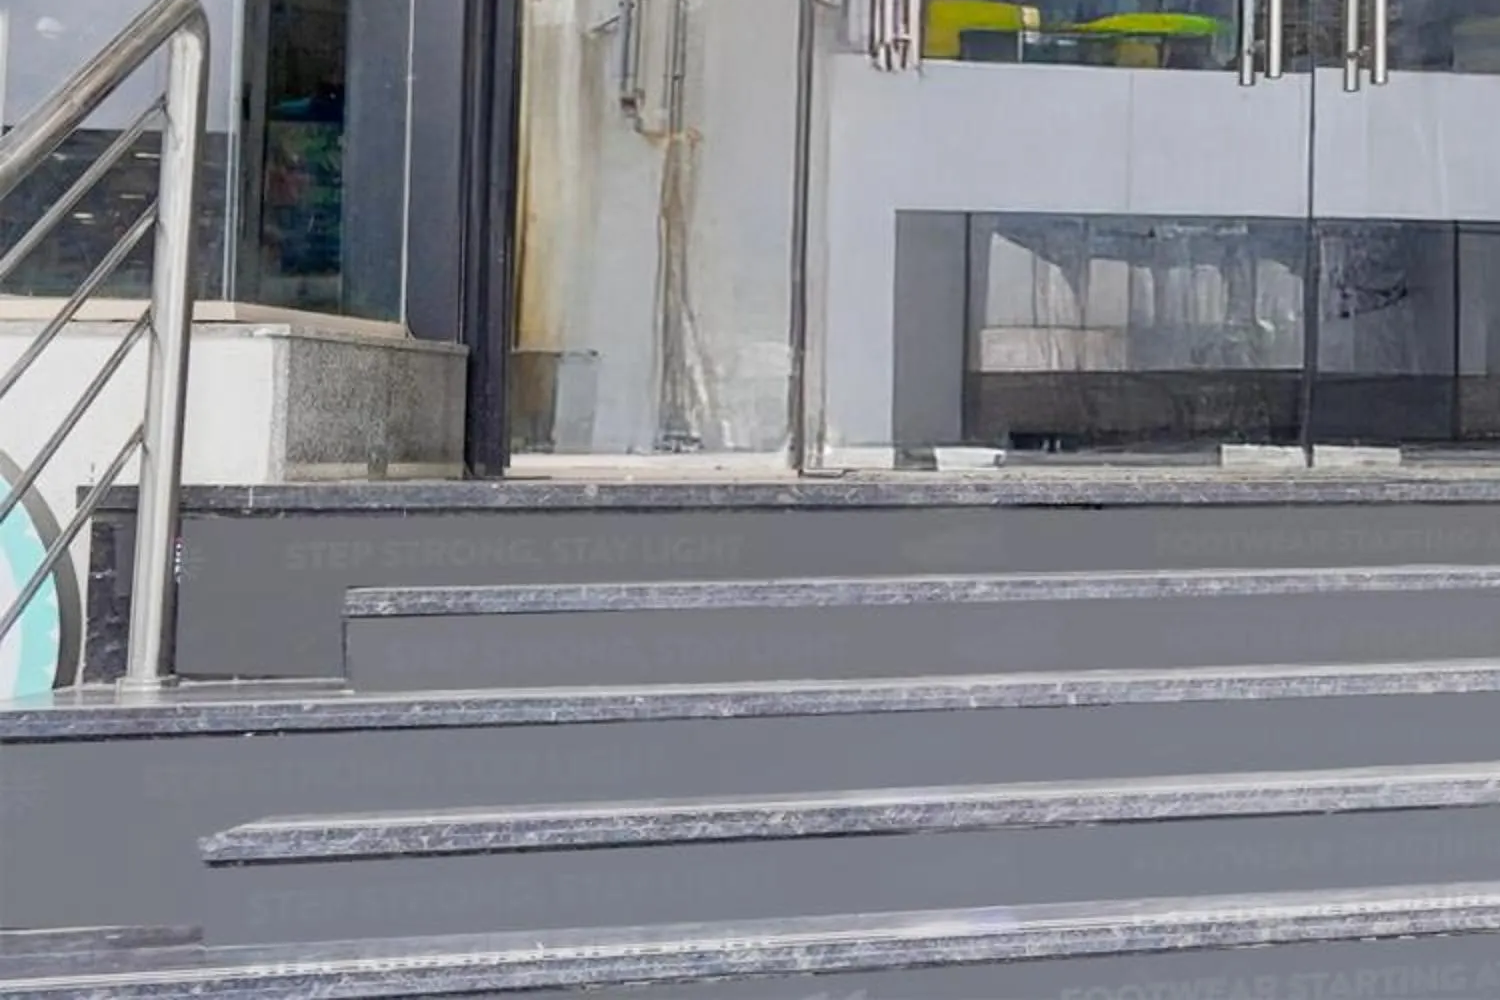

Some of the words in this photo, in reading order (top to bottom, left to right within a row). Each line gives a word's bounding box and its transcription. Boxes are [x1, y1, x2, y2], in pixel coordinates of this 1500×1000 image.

[285, 541, 372, 570] STEP
[551, 536, 630, 564] STAY
[643, 533, 746, 563] LIGHT
[1288, 964, 1467, 1000] STARTING
